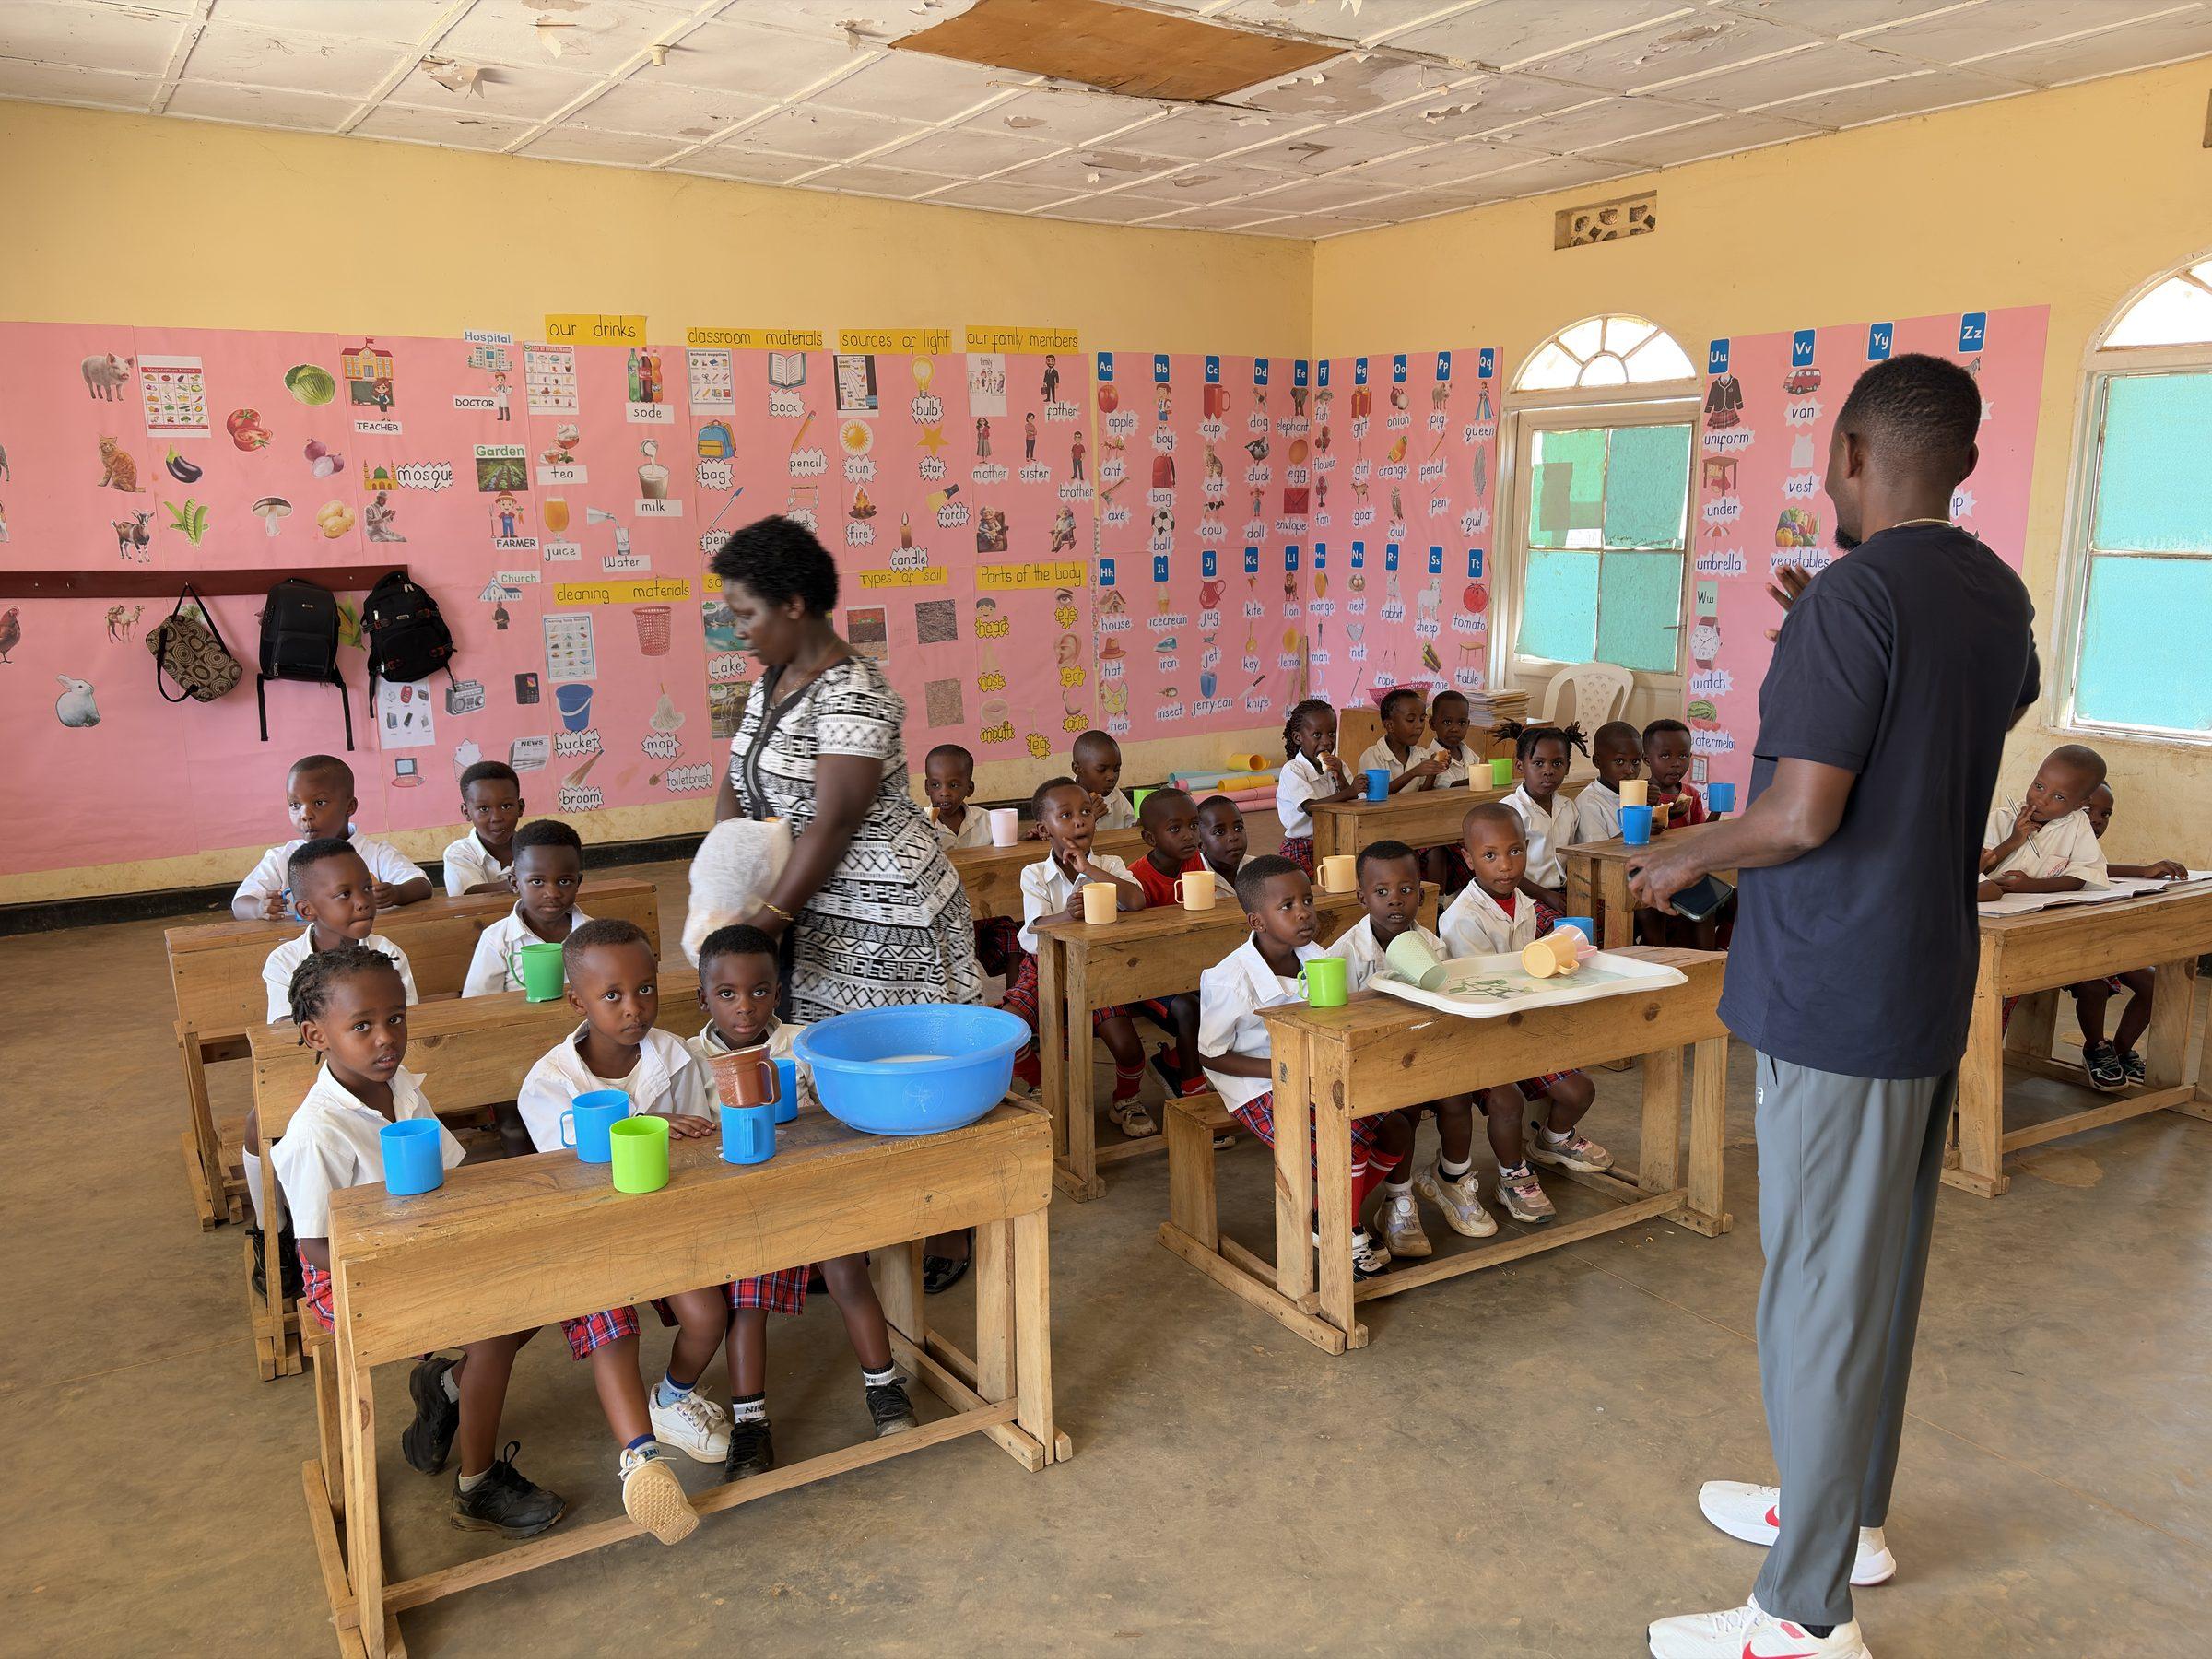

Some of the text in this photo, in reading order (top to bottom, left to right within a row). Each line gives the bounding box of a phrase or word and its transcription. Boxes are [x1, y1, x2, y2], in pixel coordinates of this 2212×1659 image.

[549, 315, 637, 338] our drinks
[1963, 325, 1981, 340] Zz
[465, 331, 511, 345] Hospital
[688, 329, 822, 347] classroom materials
[842, 329, 950, 356] sources of light
[967, 326, 1078, 355] our family members
[1873, 332, 1889, 349] Yy
[1795, 342, 1813, 355] Vv
[1479, 356, 1492, 371] Qq
[1711, 350, 1727, 363] Uu
[1099, 362, 1112, 372] Aa
[1156, 363, 1168, 373] Bb
[1206, 365, 1218, 374] Cc
[1255, 367, 1267, 377] Dd
[1319, 366, 1327, 380] Ff
[1356, 365, 1367, 377] Gg
[1394, 364, 1406, 373] Oo
[1439, 359, 1449, 373] Pp
[1297, 370, 1306, 378] Ee
[455, 398, 495, 407] DOCTOR
[916, 401, 938, 417] bulb
[634, 406, 662, 417] sode
[1046, 407, 1077, 421] father
[1316, 407, 1328, 420] fish
[1792, 407, 1814, 418] van
[357, 423, 398, 432] TEACHER
[1109, 414, 1134, 433] apple
[1250, 418, 1268, 432] dog
[1277, 419, 1308, 432] elephant
[1387, 415, 1409, 427] onion
[1430, 414, 1444, 431] pig
[1203, 424, 1220, 439] cup
[1353, 420, 1367, 439] gift
[1466, 425, 1493, 442] queen
[1156, 433, 1173, 451] boy
[1704, 433, 1749, 452] uniform
[476, 445, 524, 457] Garden
[790, 460, 822, 474] pencil
[848, 465, 869, 474] sun
[923, 463, 942, 474] star
[1103, 462, 1122, 476] ant
[1313, 456, 1335, 471] flower
[1420, 460, 1444, 481] pencil
[397, 466, 452, 488] mosque
[551, 467, 573, 478] tea
[700, 464, 726, 484] bag
[972, 467, 1007, 479] mother
[1019, 467, 1049, 478] sister
[1249, 468, 1269, 481] duck
[1288, 466, 1307, 483] egg
[1355, 463, 1369, 480] girl
[1379, 465, 1408, 480] orange
[1206, 479, 1224, 491] cat
[1789, 476, 1813, 493] vest
[1060, 488, 1094, 500] brother
[1152, 492, 1171, 508] bag
[641, 501, 665, 512] milk
[1431, 498, 1446, 513] pen
[1707, 500, 1738, 516] under
[1953, 498, 1964, 516] ip
[1108, 512, 1125, 521] axe
[1315, 515, 1329, 525] fan
[1354, 508, 1372, 526] goat
[849, 526, 869, 540] fire
[1202, 525, 1223, 535] cow
[1247, 524, 1265, 539] doll
[1389, 524, 1406, 537] owl
[497, 538, 535, 547] FARMER
[705, 535, 726, 550] pen
[1153, 536, 1171, 551] ball
[545, 546, 576, 561] juice
[891, 550, 926, 566] candle
[1246, 555, 1257, 565] Kk
[1352, 549, 1363, 560] Nn
[1387, 552, 1396, 563] Rr
[1431, 555, 1441, 565] Ss
[1771, 550, 1829, 569] vegetables
[604, 556, 640, 568] Water
[1206, 557, 1214, 571] Jj
[1471, 559, 1480, 569] Tt
[1697, 554, 1741, 571] umbrella
[501, 574, 536, 583] Church
[901, 573, 913, 586] of
[924, 566, 943, 581] soil
[981, 565, 1081, 586] Parts of the body
[1100, 568, 1113, 578] Hh
[557, 584, 609, 604] cleaning
[633, 578, 689, 598] materials
[1697, 591, 1714, 604] Ww
[1246, 606, 1262, 617] kite
[1284, 605, 1298, 617] lion
[1310, 603, 1335, 616] mango
[1349, 601, 1364, 611] nest
[1382, 607, 1402, 619] rabbit
[978, 617, 1007, 634] head
[1057, 609, 1077, 628] eye
[1101, 617, 1130, 631] house
[1149, 613, 1187, 628] icecream
[1201, 611, 1218, 628] jug
[1453, 616, 1485, 631] tomato
[1416, 622, 1438, 639] sheep
[1203, 646, 1218, 668] jet
[1312, 652, 1327, 662] man
[1351, 649, 1364, 658] net
[711, 656, 744, 675] Lake
[1104, 662, 1121, 677] hat
[1160, 656, 1177, 669] iron
[1244, 657, 1258, 673] key
[1378, 677, 1394, 689] rope
[1457, 673, 1478, 686] table
[1693, 676, 1725, 689] watch
[1157, 705, 1182, 720] insect
[1246, 699, 1268, 712] knife
[1111, 720, 1128, 734] hen
[556, 736, 597, 752] bucket
[647, 740, 674, 754] mop
[1030, 736, 1048, 756] leg
[562, 790, 600, 805] broom
